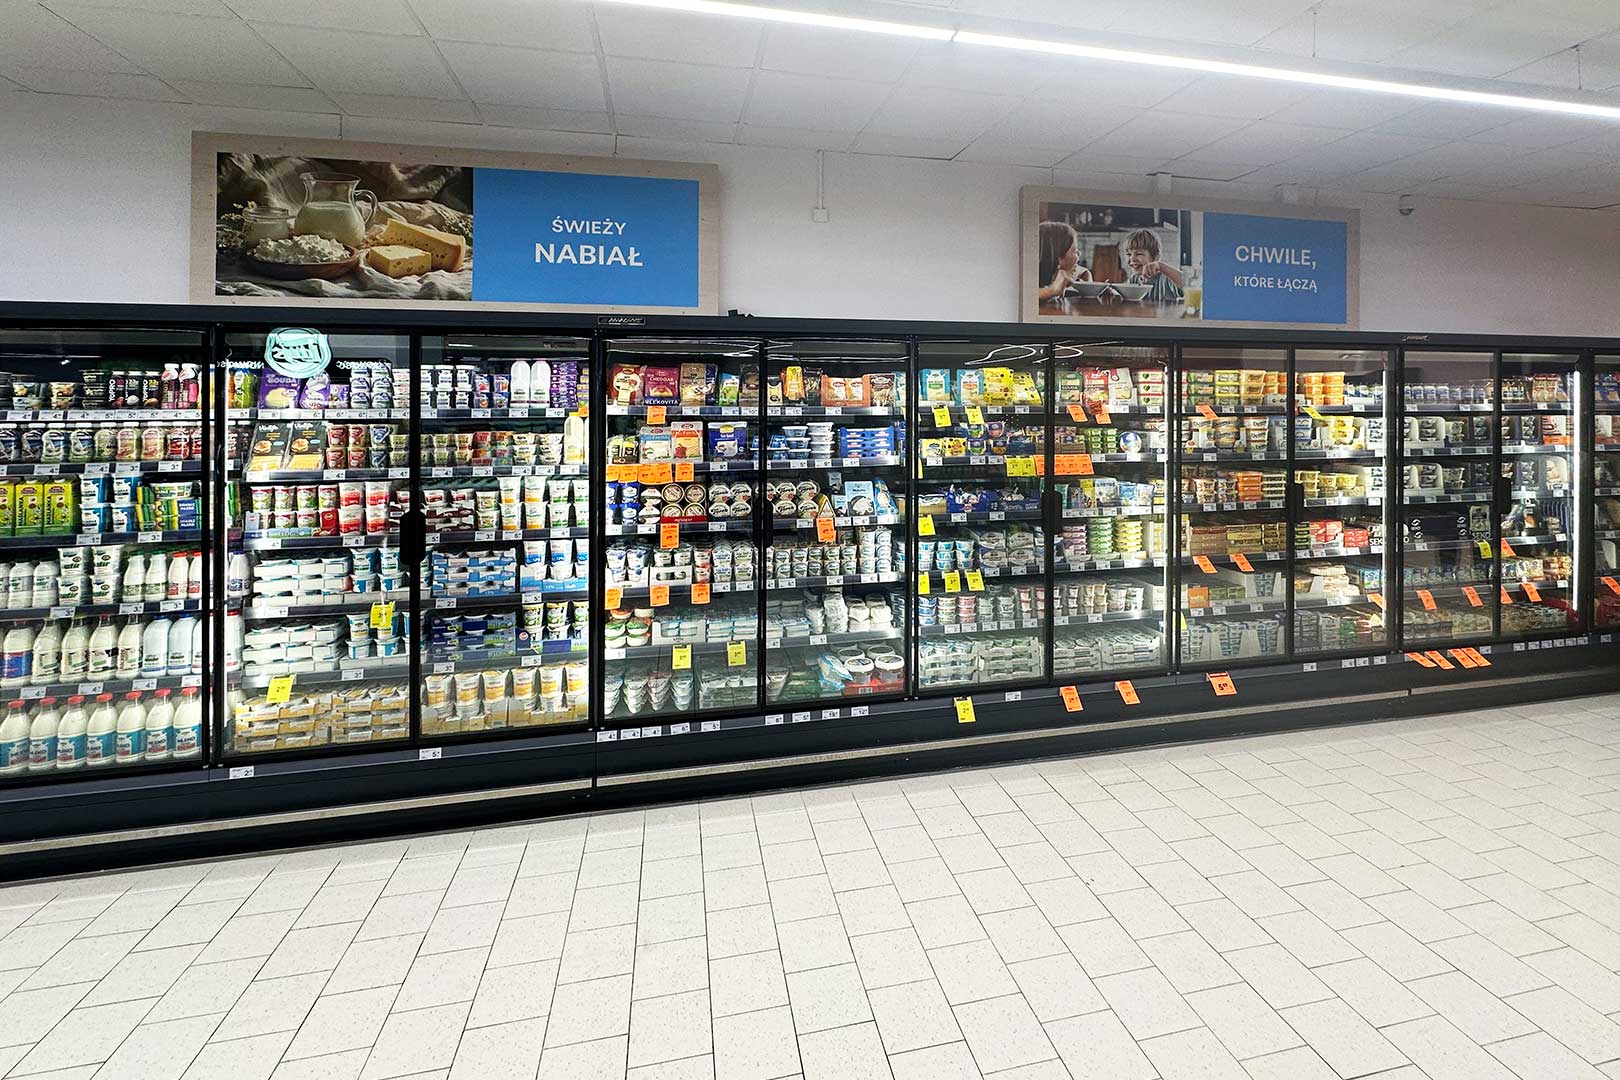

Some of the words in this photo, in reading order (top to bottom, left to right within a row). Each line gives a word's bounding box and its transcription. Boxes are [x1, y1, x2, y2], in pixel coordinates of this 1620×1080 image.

[552, 216, 627, 235] ŚWIEŻY
[535, 243, 643, 266] NABIAŁ
[1235, 245, 1317, 269] CHWILE,
[1234, 274, 1274, 289] KTÓRE
[1277, 278, 1318, 293] ŁĄCZĄ
